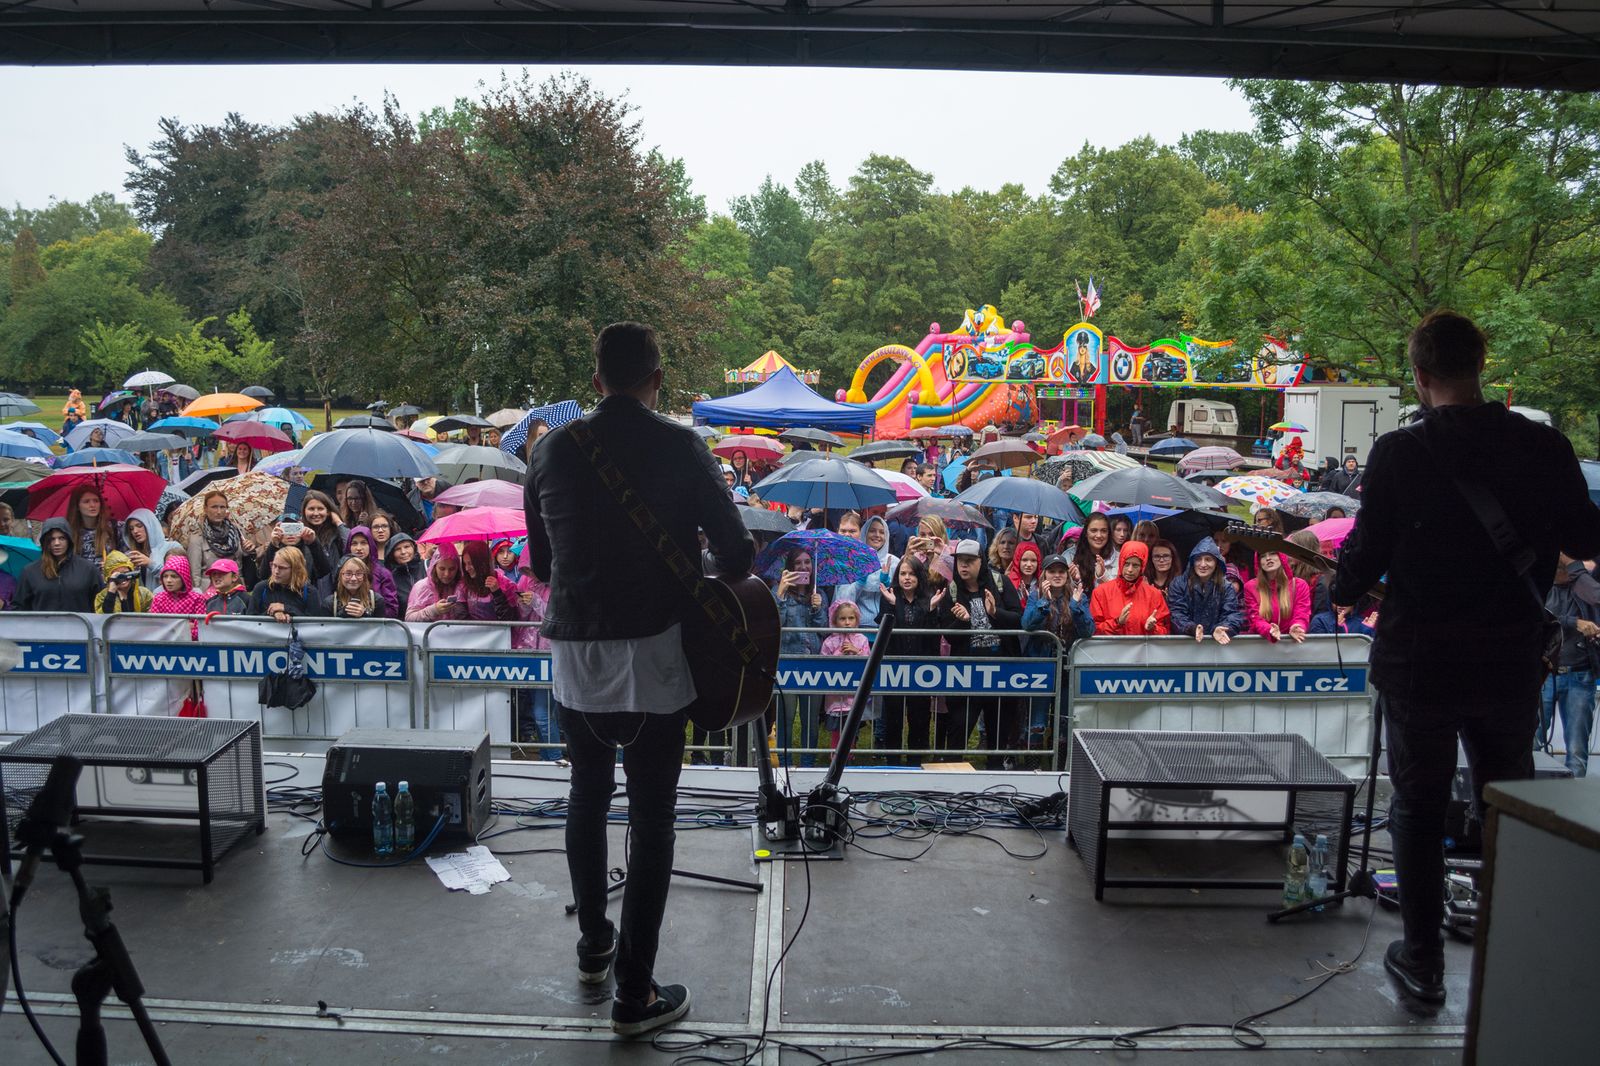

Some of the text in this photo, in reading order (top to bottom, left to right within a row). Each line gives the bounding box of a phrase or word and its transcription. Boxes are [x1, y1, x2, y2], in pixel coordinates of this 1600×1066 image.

[117, 649, 402, 678] www.IMONT.cz
[775, 664, 1048, 689] ww.MONT.cz
[1094, 671, 1349, 694] www.IMONT.cz
